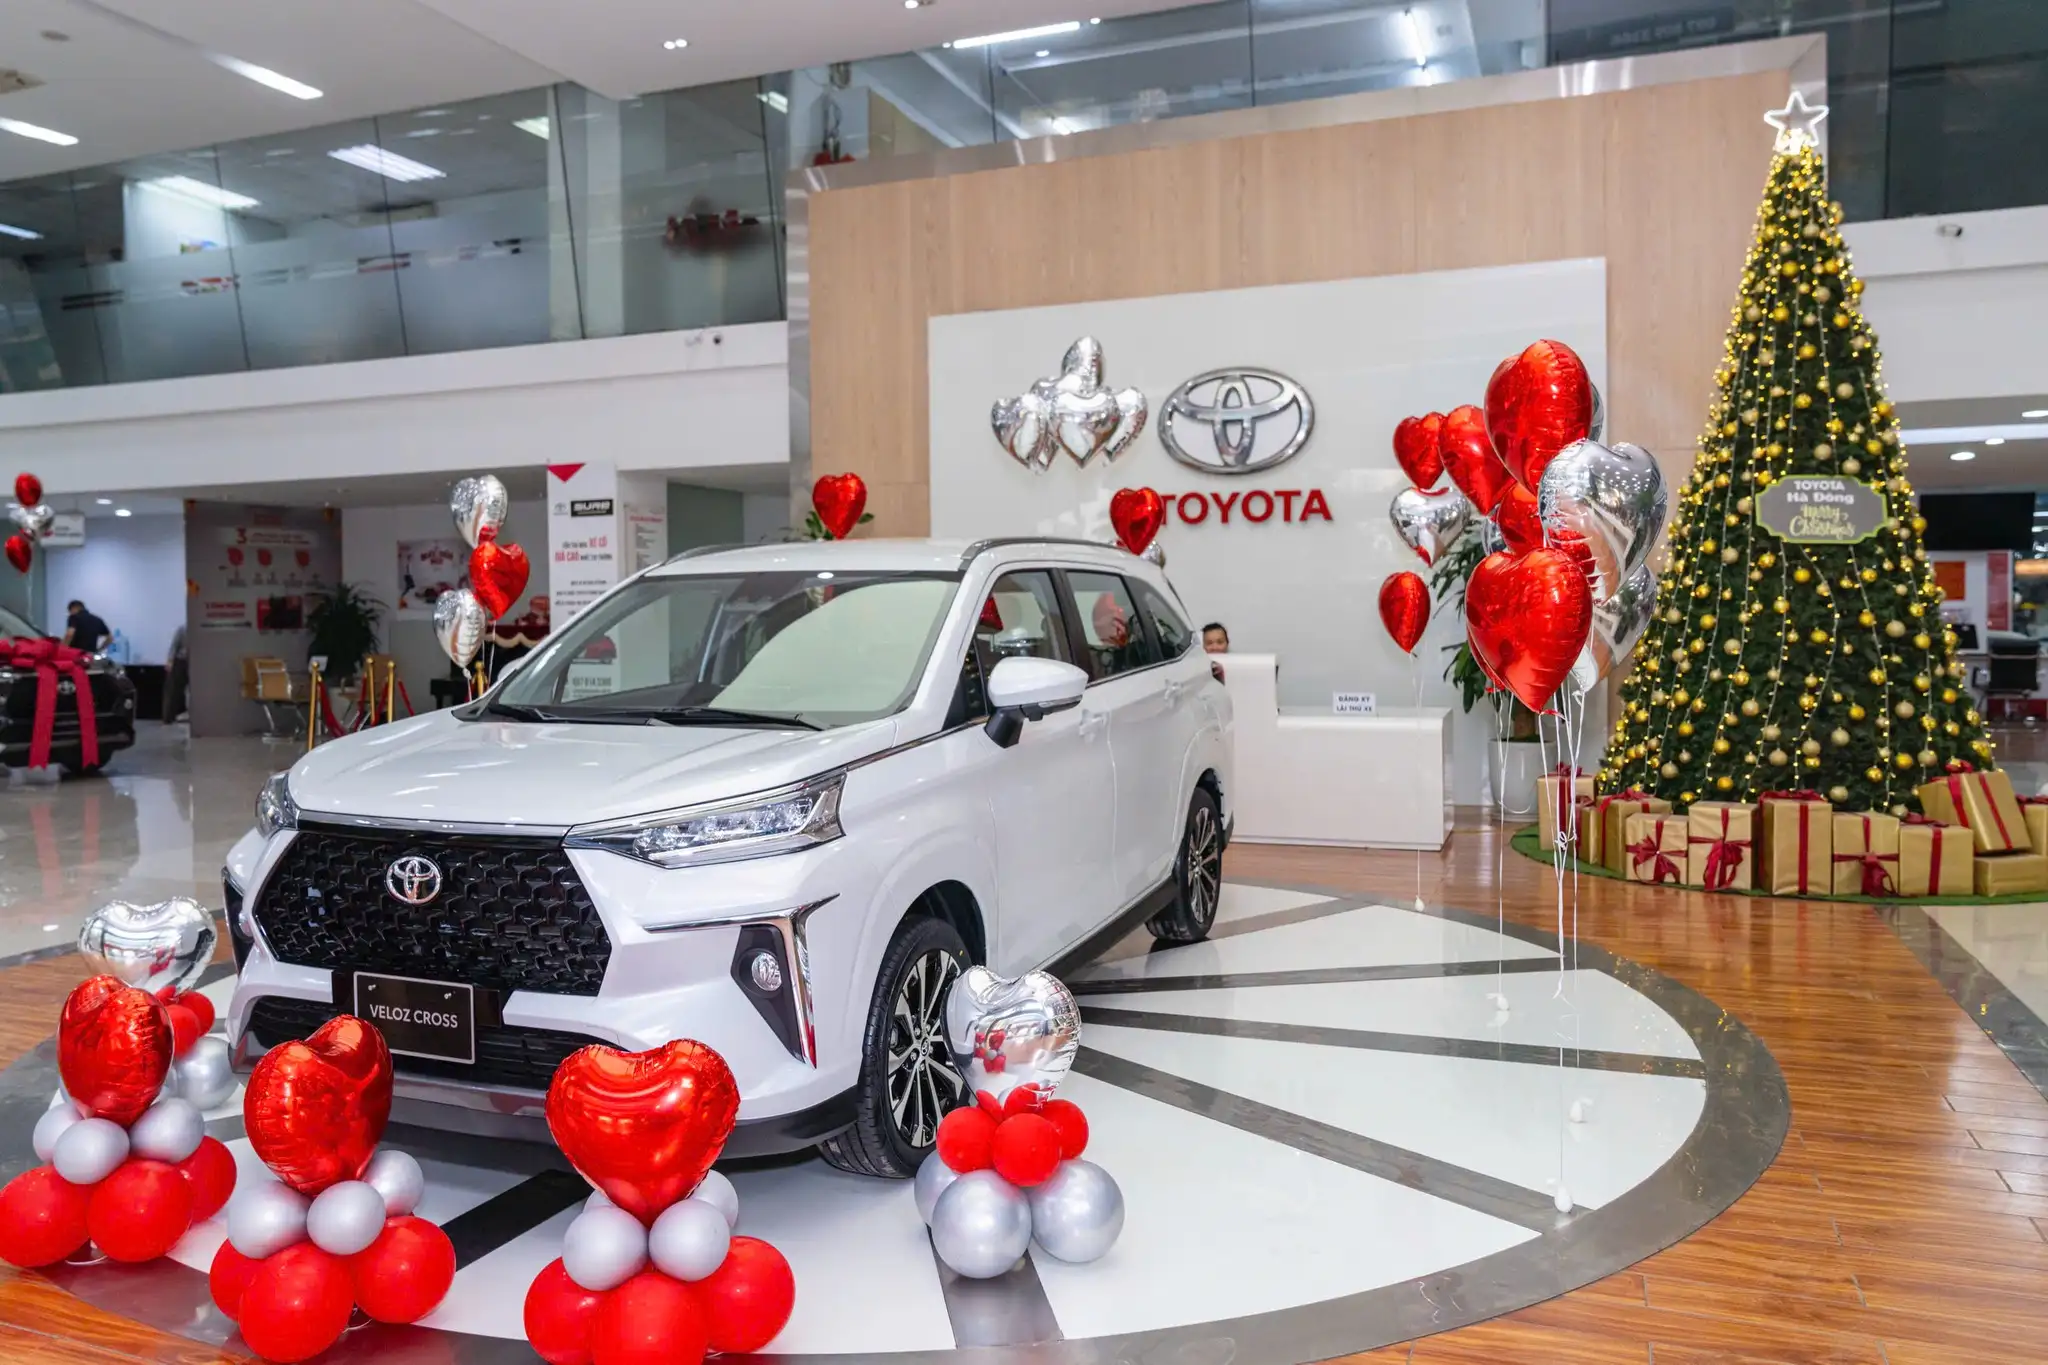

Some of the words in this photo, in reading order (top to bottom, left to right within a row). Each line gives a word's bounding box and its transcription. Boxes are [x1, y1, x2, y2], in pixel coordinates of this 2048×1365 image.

[1793, 480, 1845, 491] TOYOTA
[369, 1004, 411, 1022] VELOZ
[413, 1010, 458, 1029] CROSS
